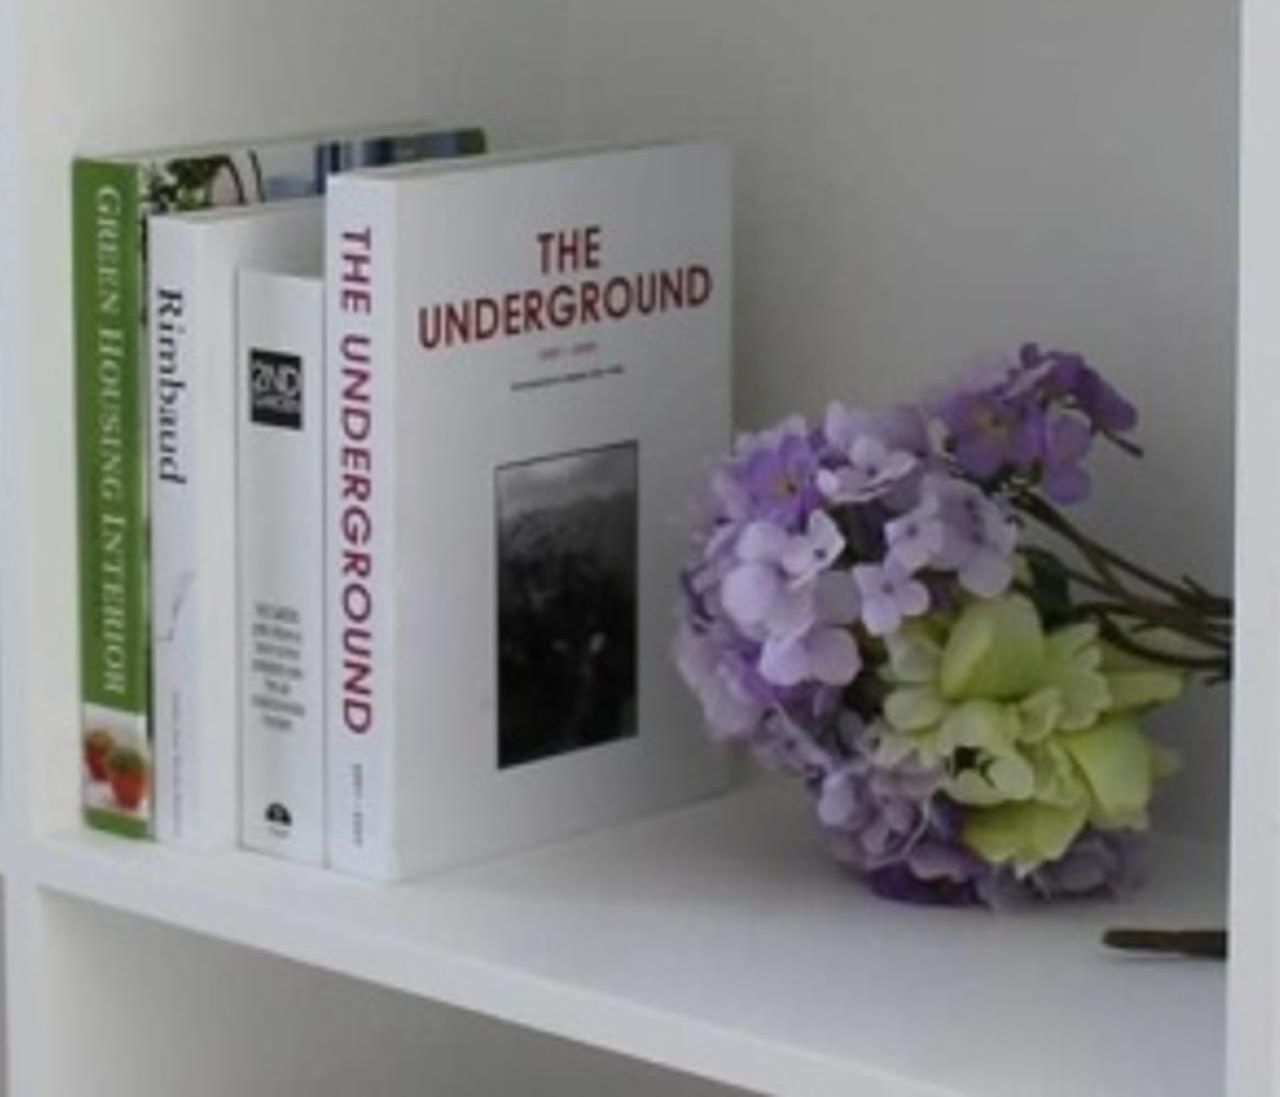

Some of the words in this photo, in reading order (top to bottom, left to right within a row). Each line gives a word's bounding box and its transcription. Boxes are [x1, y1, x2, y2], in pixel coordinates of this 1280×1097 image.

[96, 184, 122, 315] GREEN
[340, 228, 373, 320] THE
[419, 264, 714, 349] UNDERGROUND
[537, 225, 603, 274] THE
[98, 325, 125, 503] HOUSING
[157, 289, 187, 485] Rimbaud
[101, 513, 128, 695] INTERIOR
[340, 335, 373, 737] UNDERGROUND
